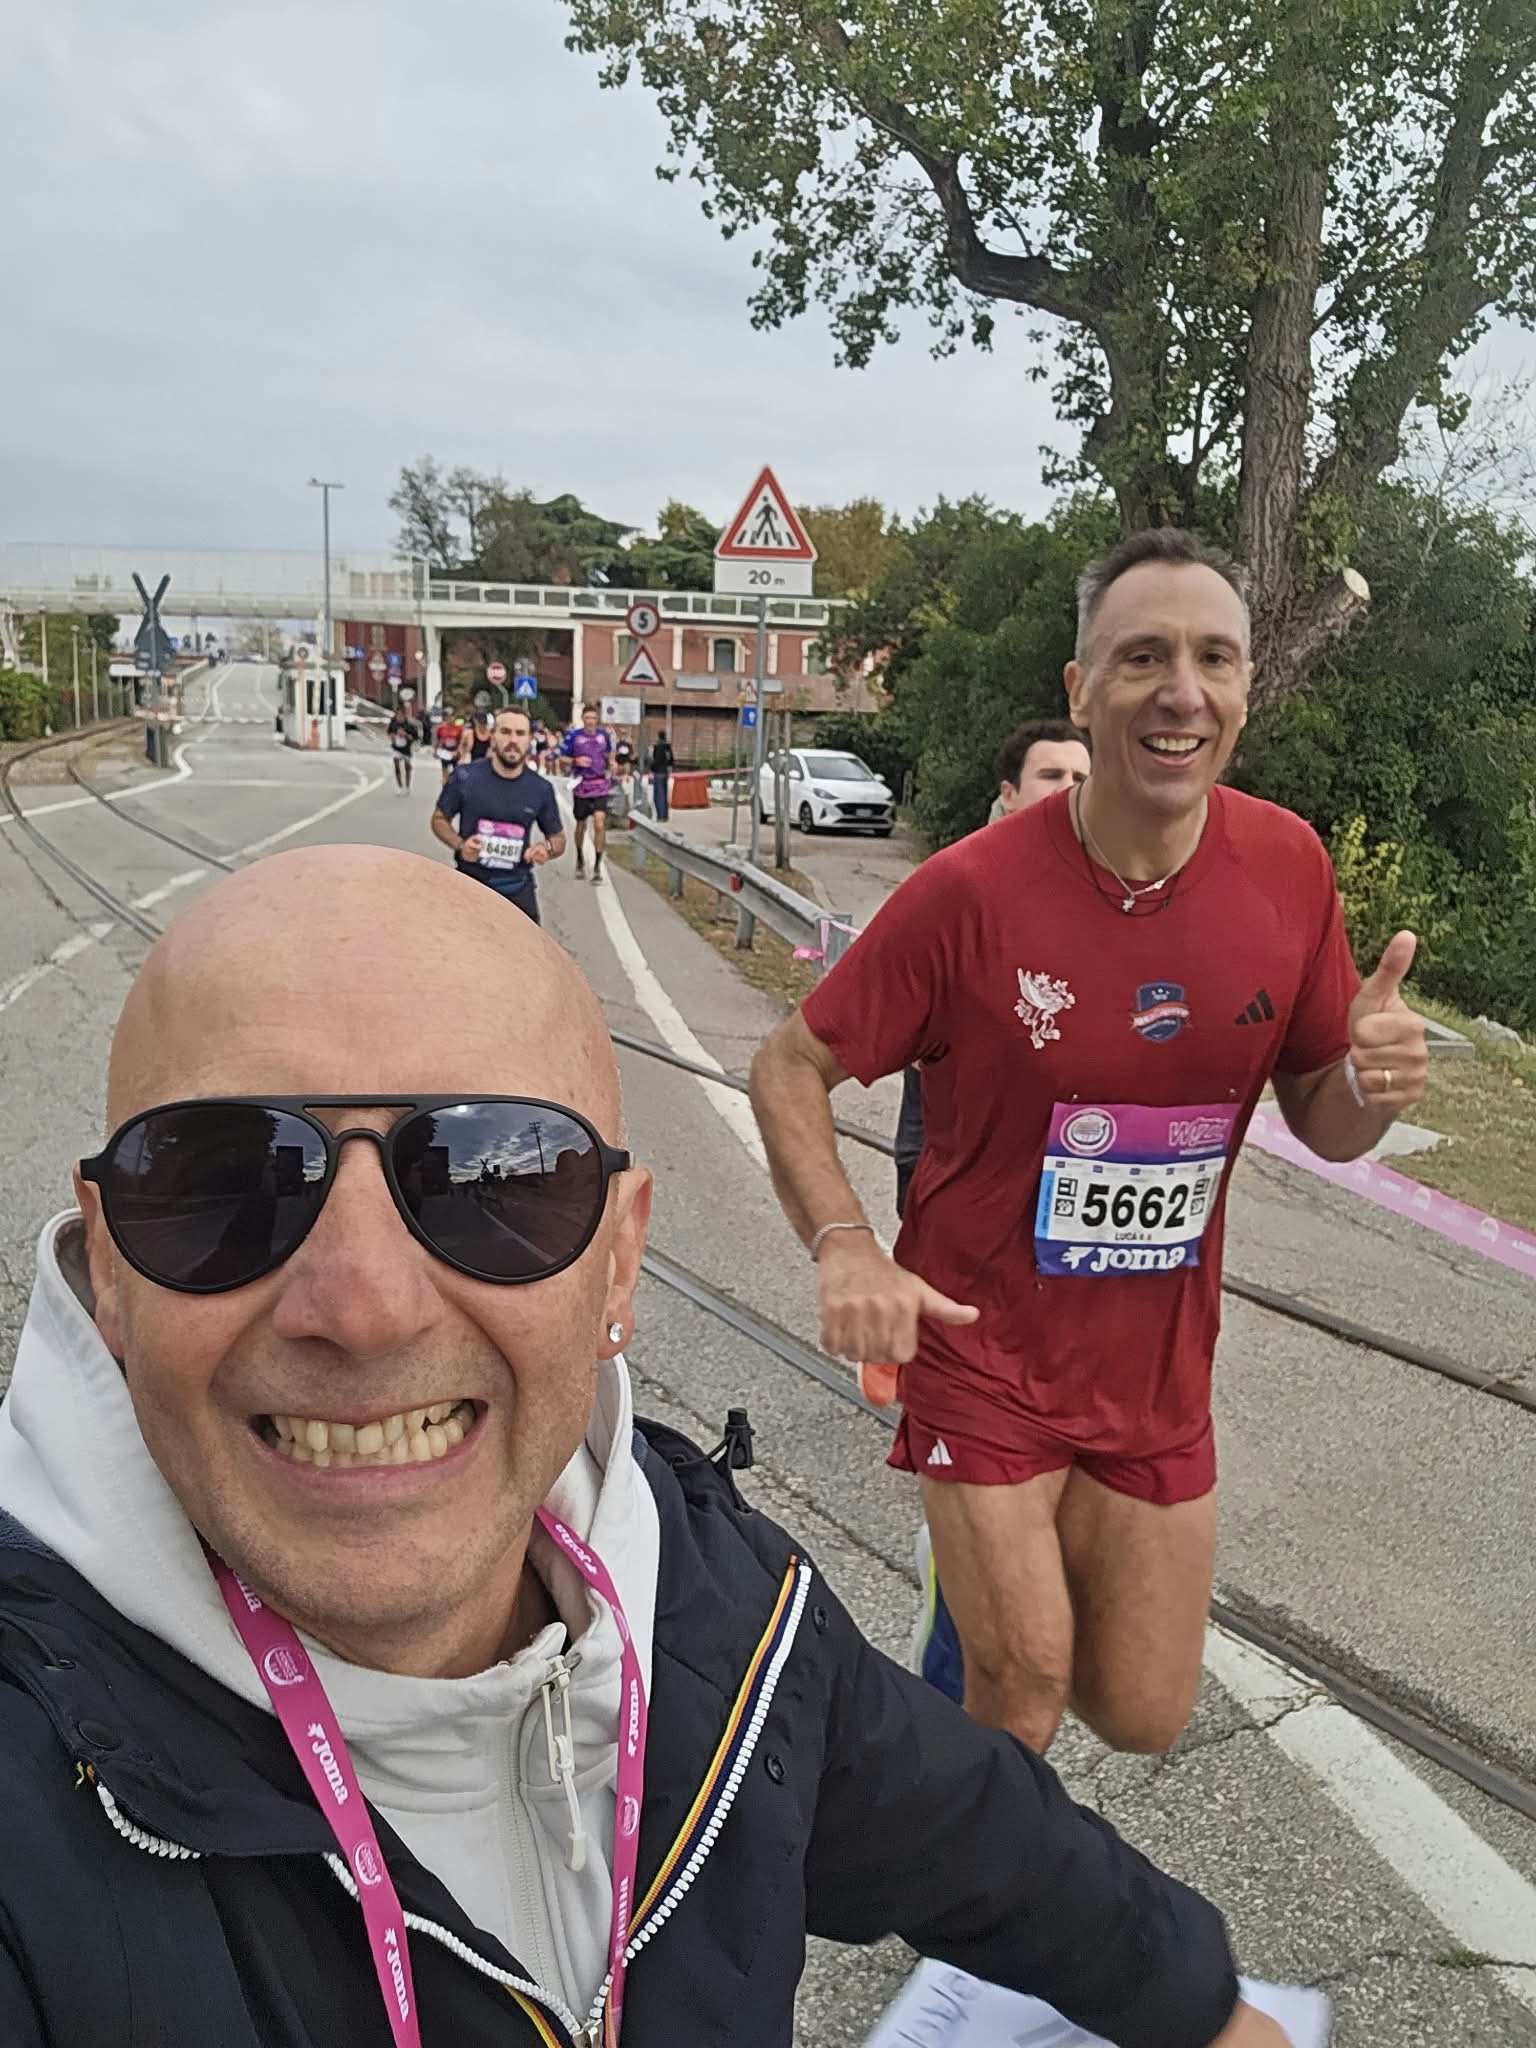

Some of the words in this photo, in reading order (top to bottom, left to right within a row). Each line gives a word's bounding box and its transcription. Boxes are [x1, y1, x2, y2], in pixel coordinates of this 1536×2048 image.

[748, 569, 772, 585] 20
[774, 576, 786, 586] m
[637, 611, 650, 630] 5
[1080, 1183, 1190, 1229] 5662
[1114, 1232, 1138, 1241] LUCA
[311, 1738, 349, 1806] Joma
